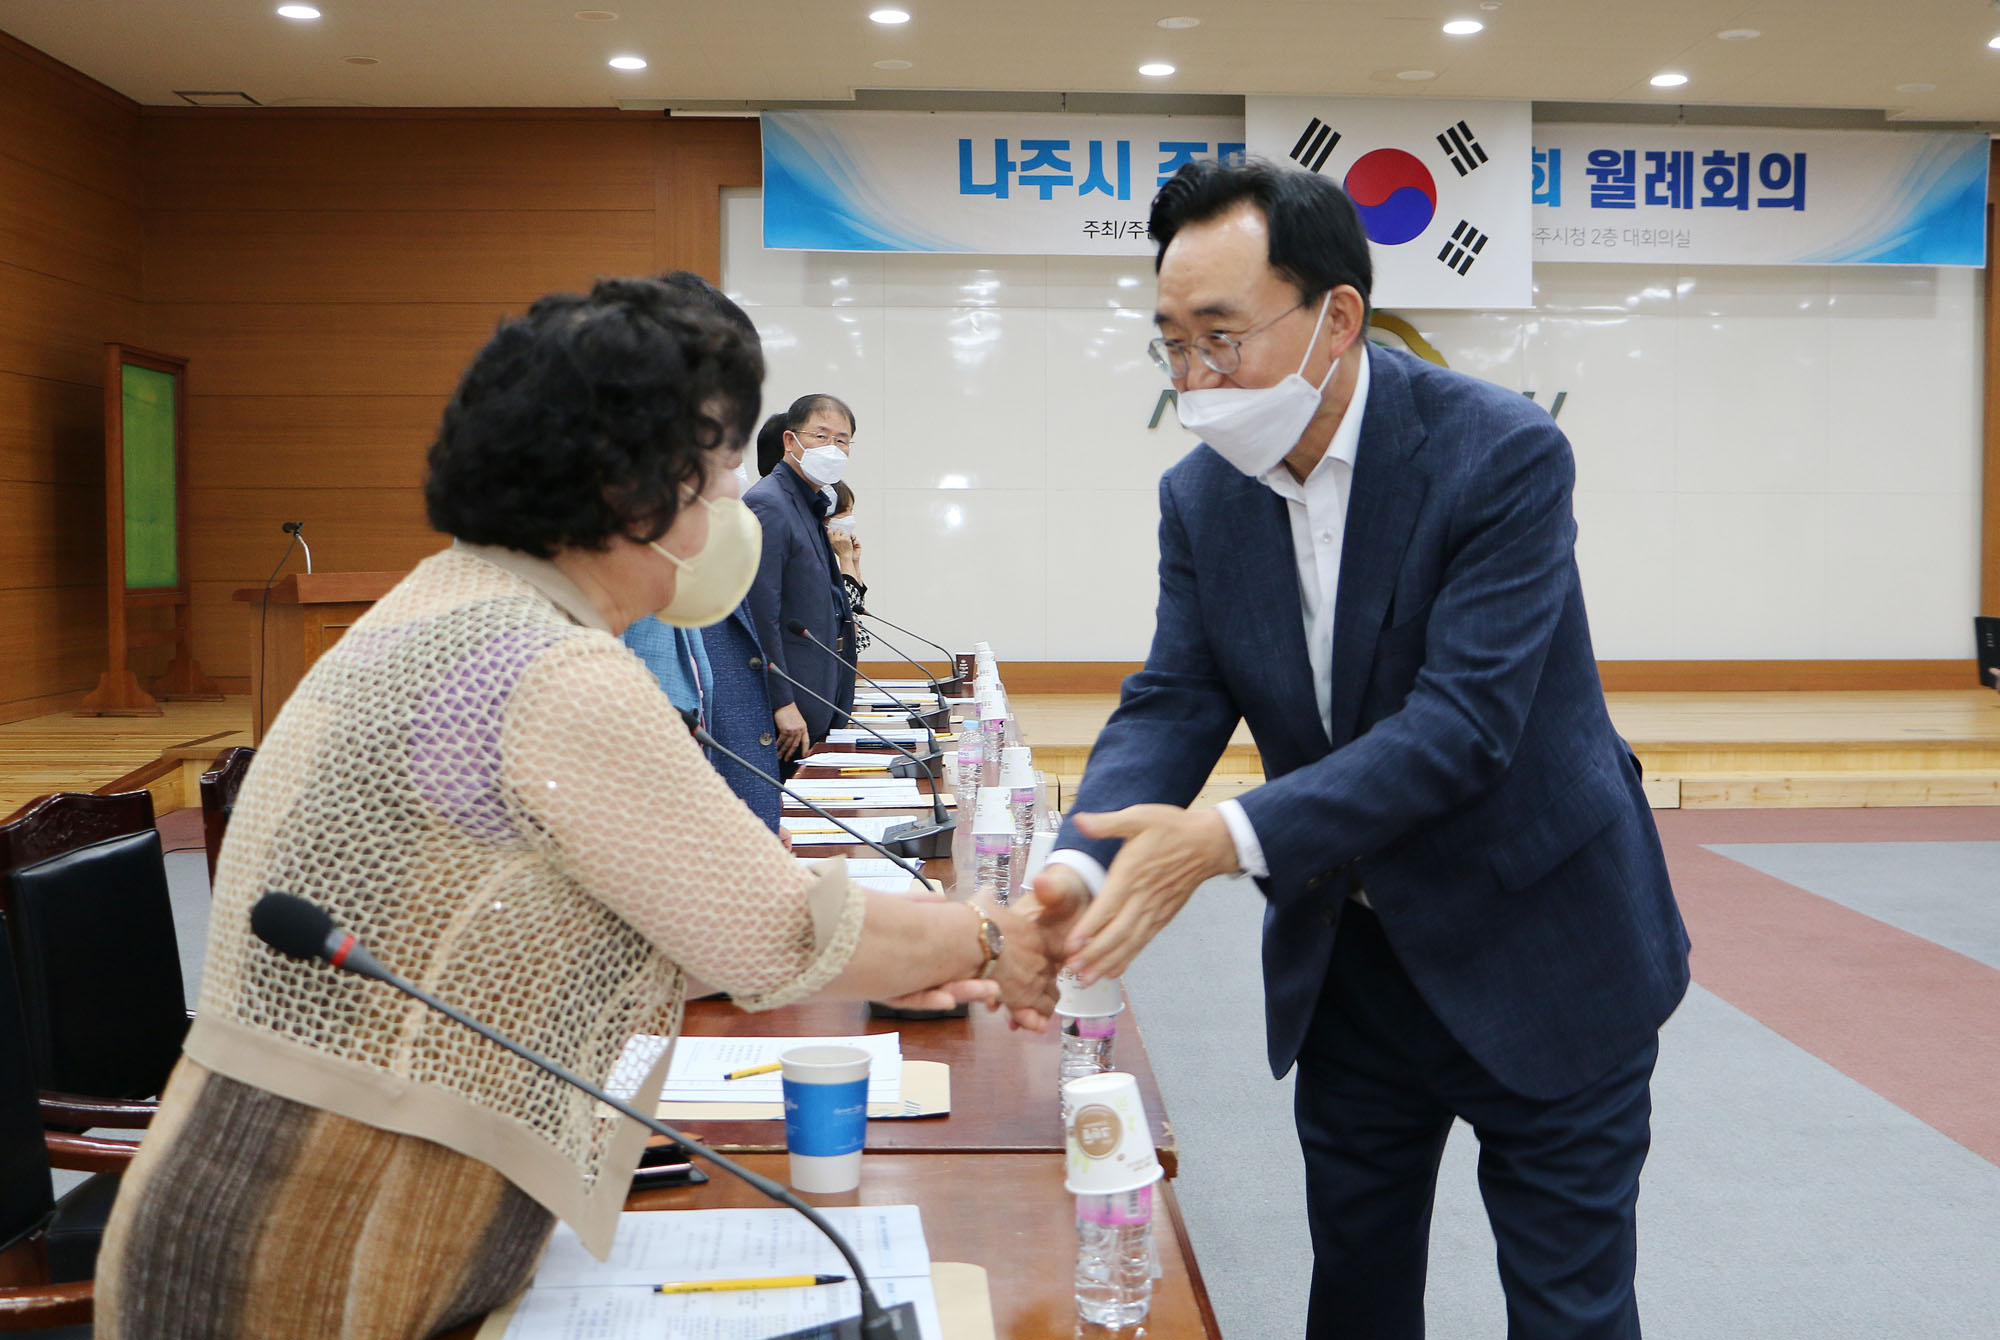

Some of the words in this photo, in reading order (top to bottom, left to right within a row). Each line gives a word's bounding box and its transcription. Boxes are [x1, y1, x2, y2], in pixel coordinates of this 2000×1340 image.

[958, 138, 1131, 201] 나주시
[1585, 149, 1807, 212] 월례회의
[1082, 219, 1153, 240] 주최/주
[1531, 226, 1586, 248] 주시청
[1591, 227, 1619, 248] 2층
[1623, 228, 1692, 249] 대회의실
